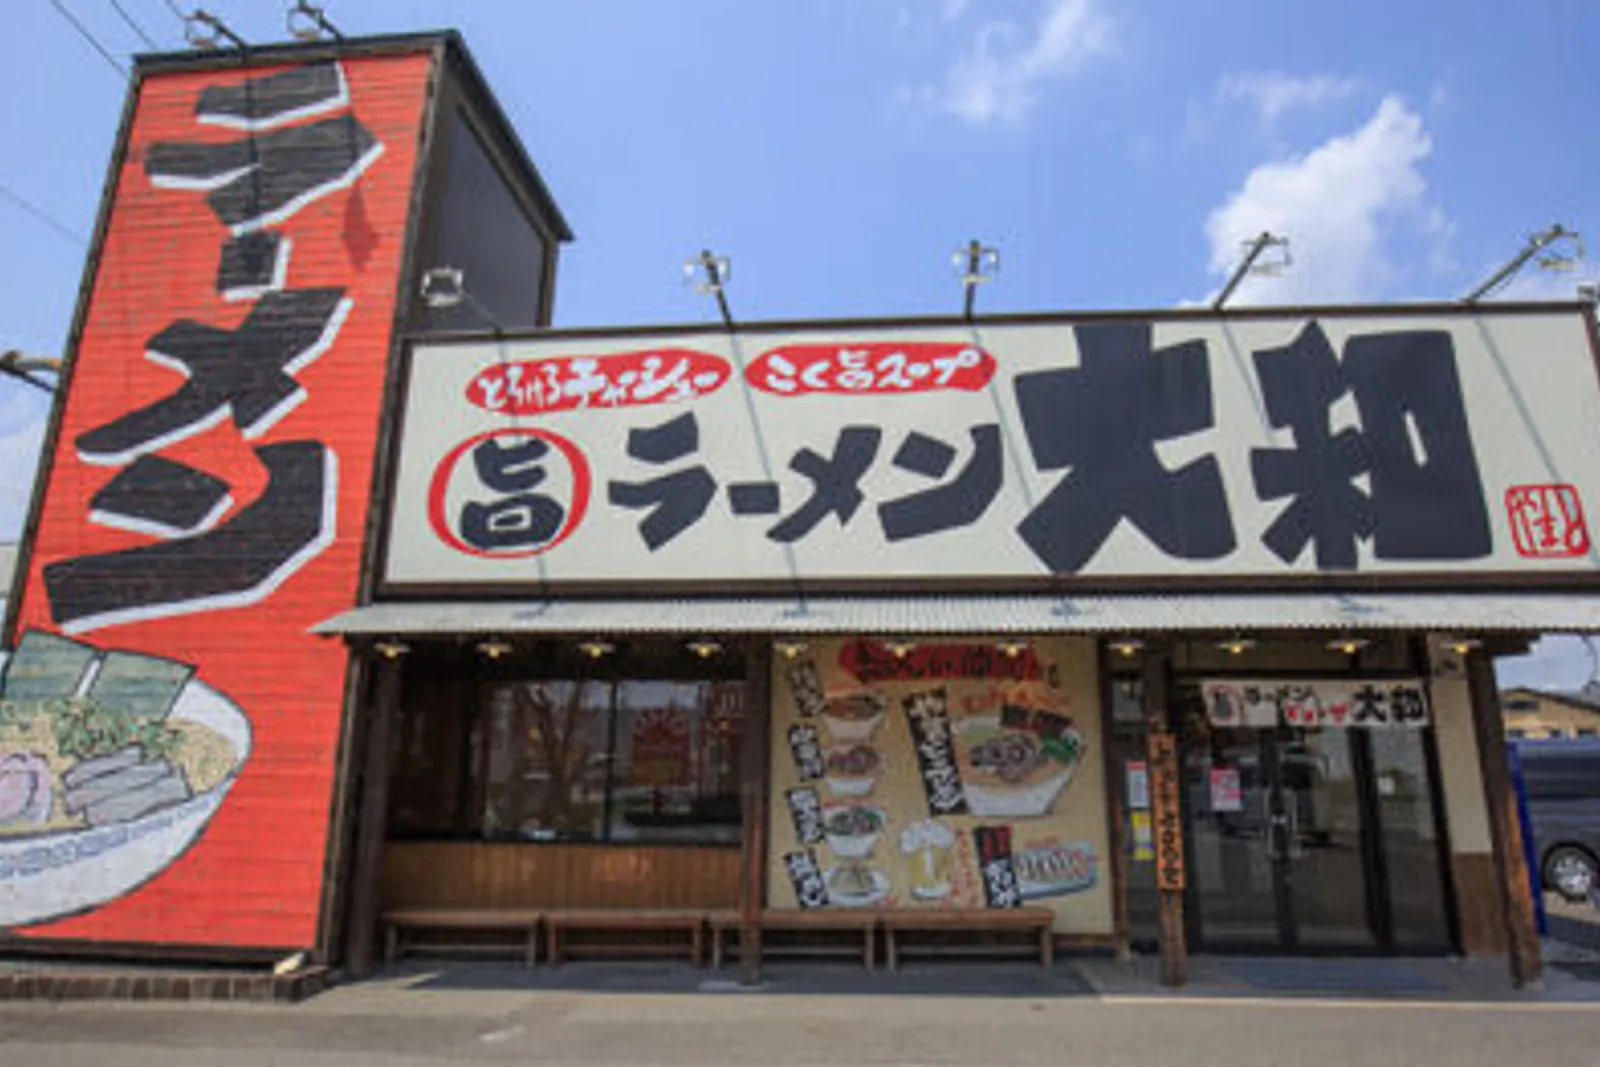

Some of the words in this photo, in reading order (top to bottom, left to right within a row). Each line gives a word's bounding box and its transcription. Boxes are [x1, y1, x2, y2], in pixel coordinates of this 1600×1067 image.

[40, 61, 386, 635] ラーメン
[766, 348, 982, 392] こく旨スープ
[477, 356, 721, 409] とろけるチャーシュー
[457, 436, 567, 552] 旨
[607, 411, 1005, 553] ラーメン
[1012, 320, 1494, 573] 大和
[1352, 685, 1425, 723] 大和
